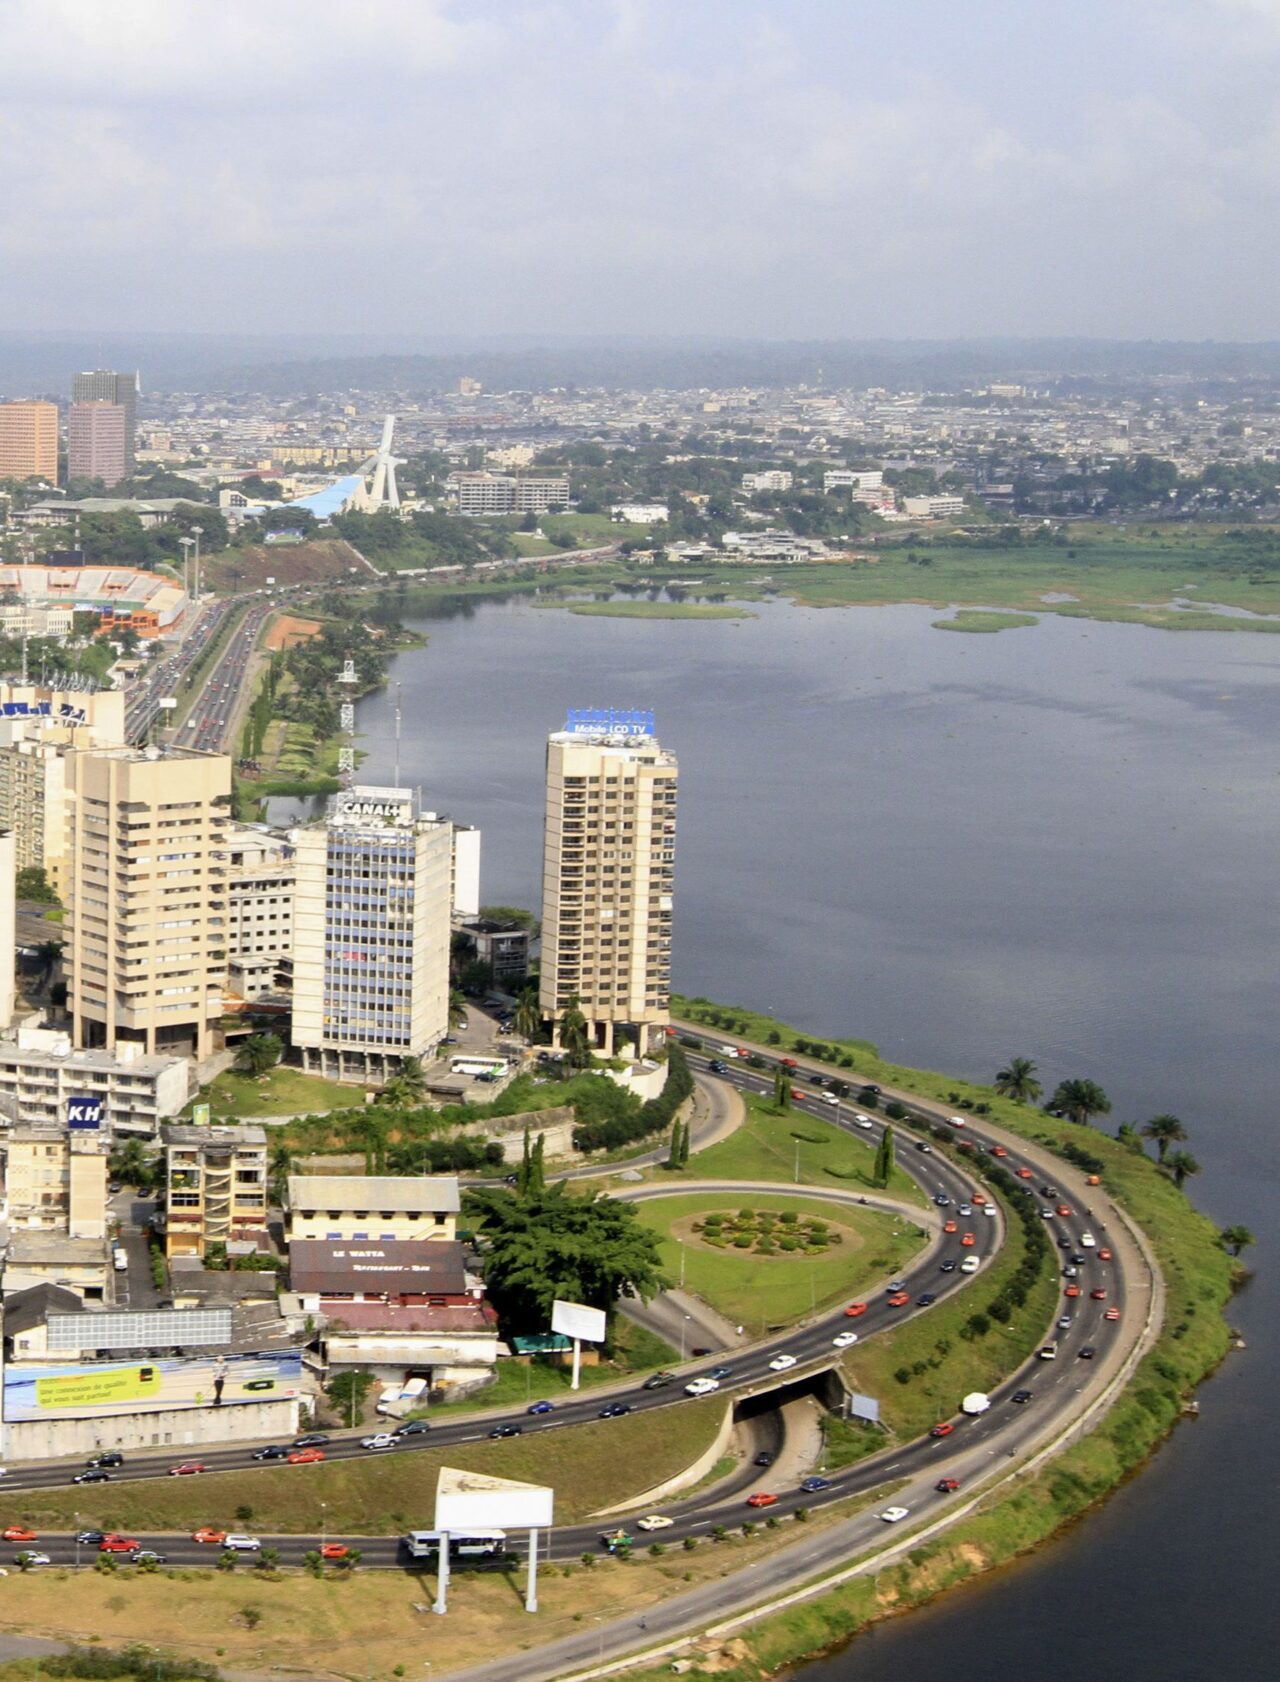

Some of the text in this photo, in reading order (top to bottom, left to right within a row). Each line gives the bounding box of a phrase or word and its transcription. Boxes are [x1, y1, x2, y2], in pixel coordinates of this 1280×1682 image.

[575, 724, 646, 734] Mobile LCD TV
[343, 802, 400, 816] CANAL+
[68, 1105, 100, 1122] KH
[332, 1250, 386, 1258] LE WATTA
